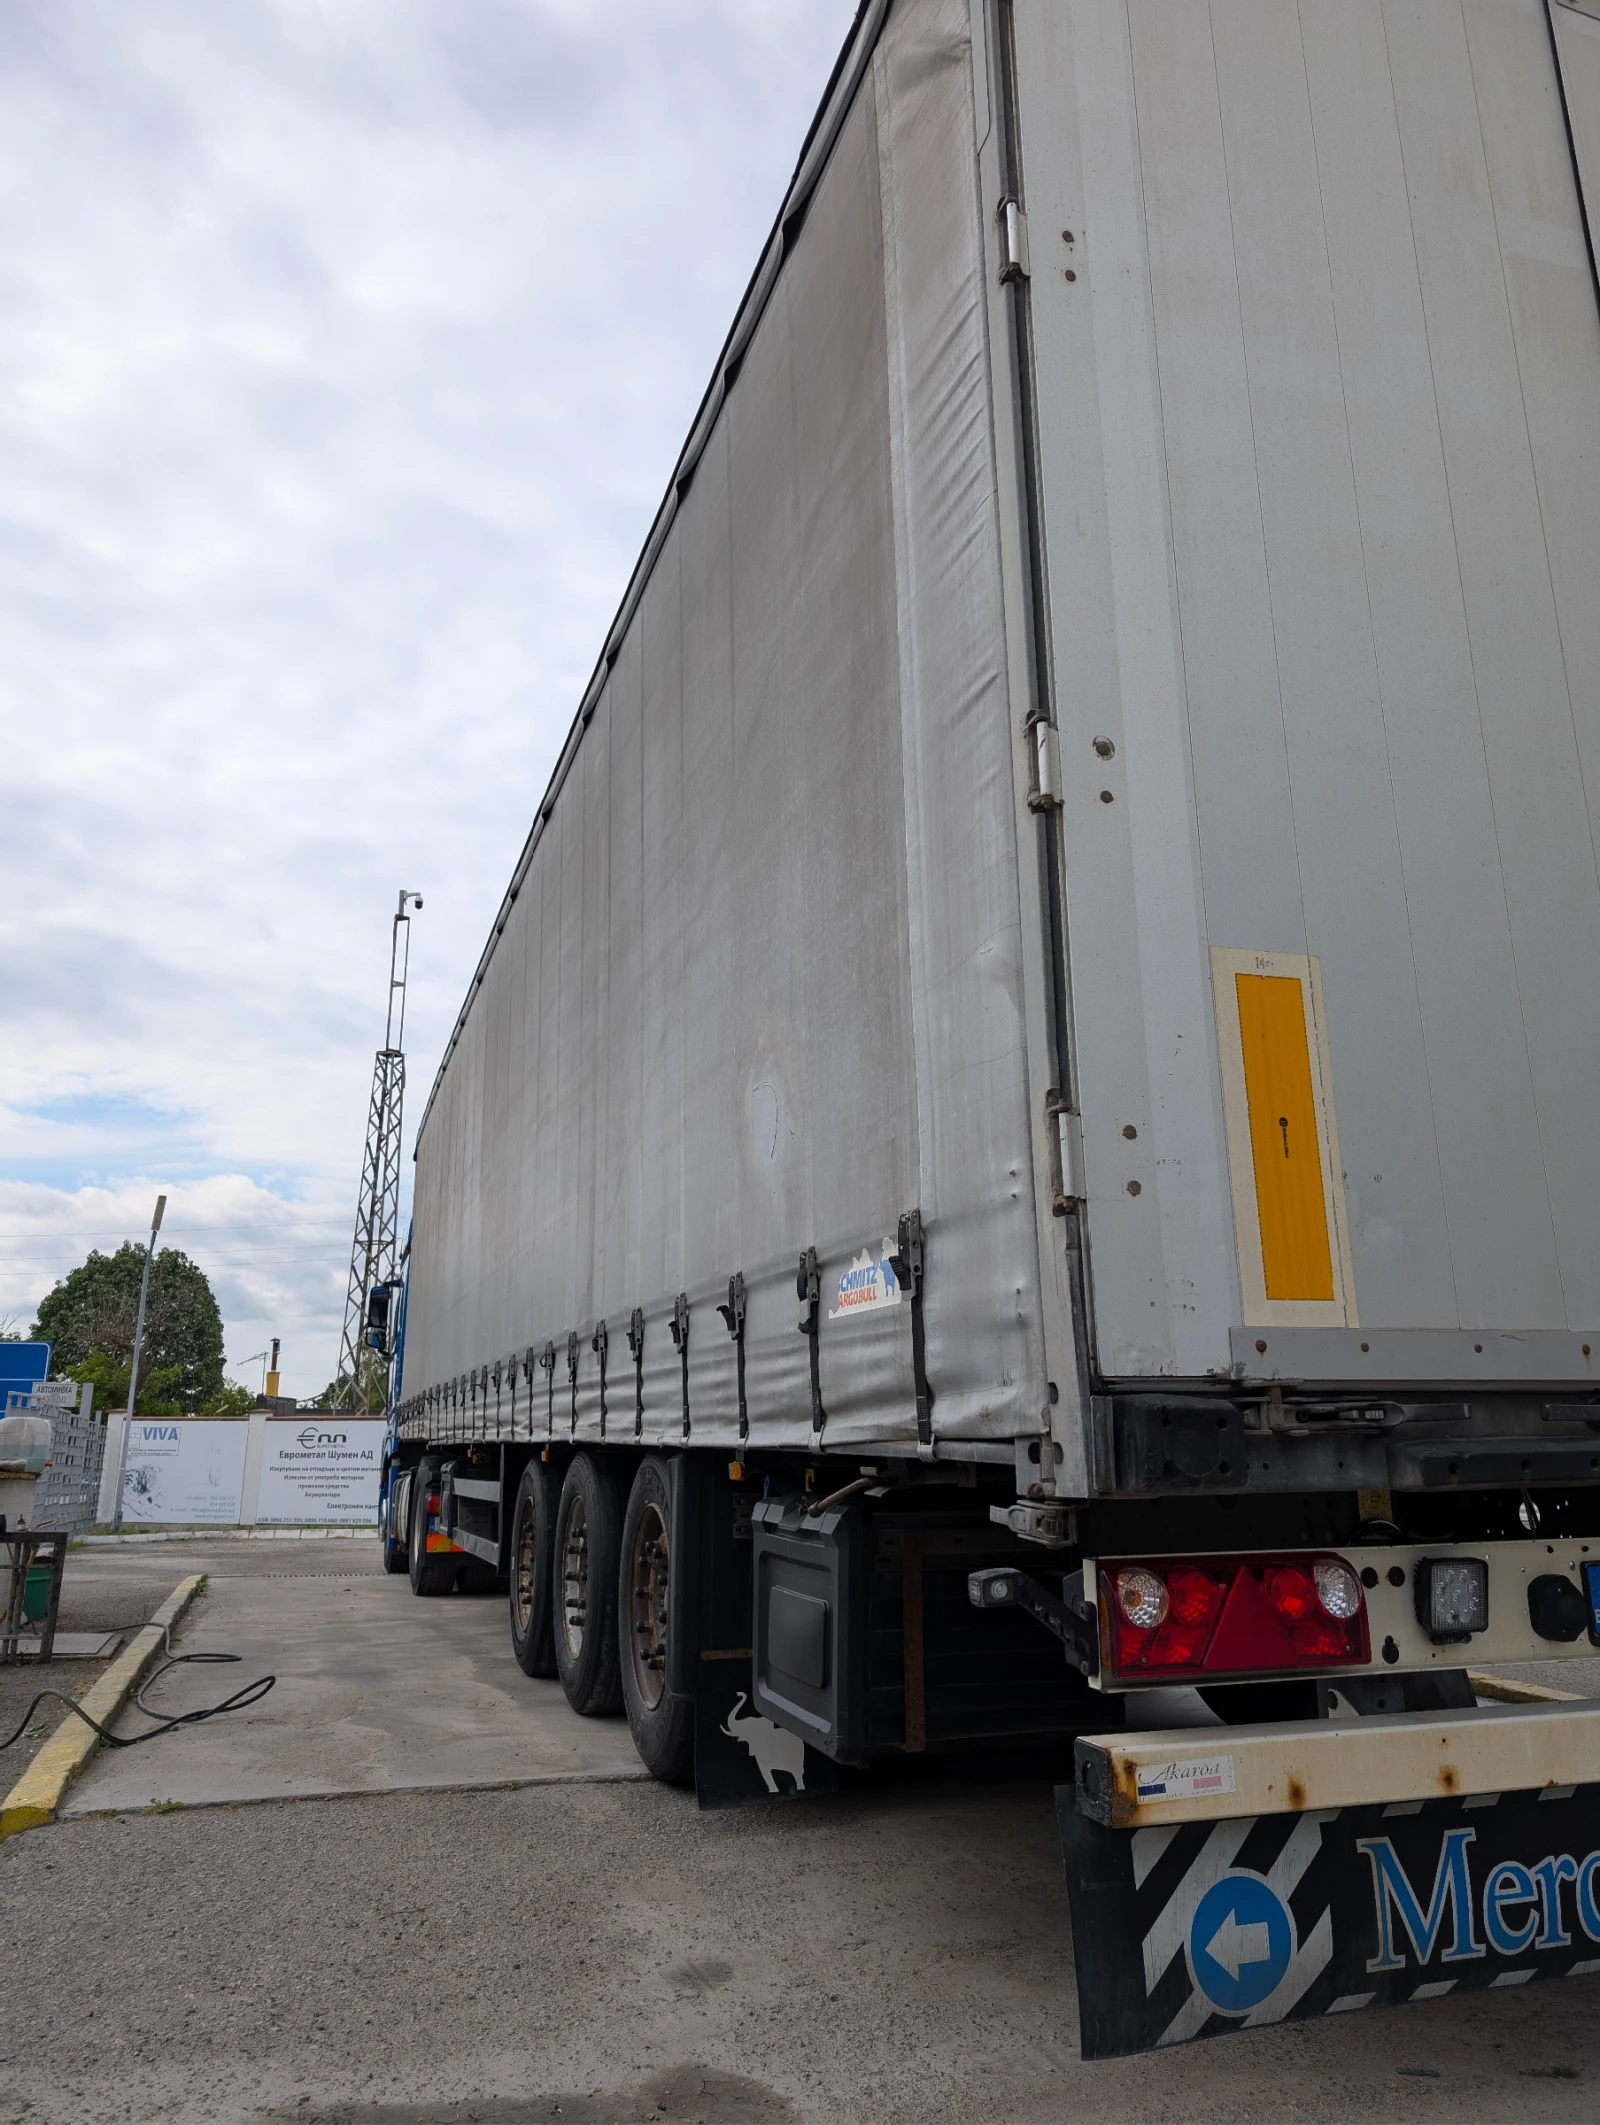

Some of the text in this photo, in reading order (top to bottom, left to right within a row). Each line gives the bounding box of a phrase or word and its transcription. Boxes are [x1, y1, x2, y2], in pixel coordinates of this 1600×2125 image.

[840, 1265, 878, 1293] CHMITZ
[838, 1286, 877, 1308] ARGOBULL
[143, 1427, 178, 1441] VIVA
[279, 1450, 374, 1461] Еврометал Шумен АД
